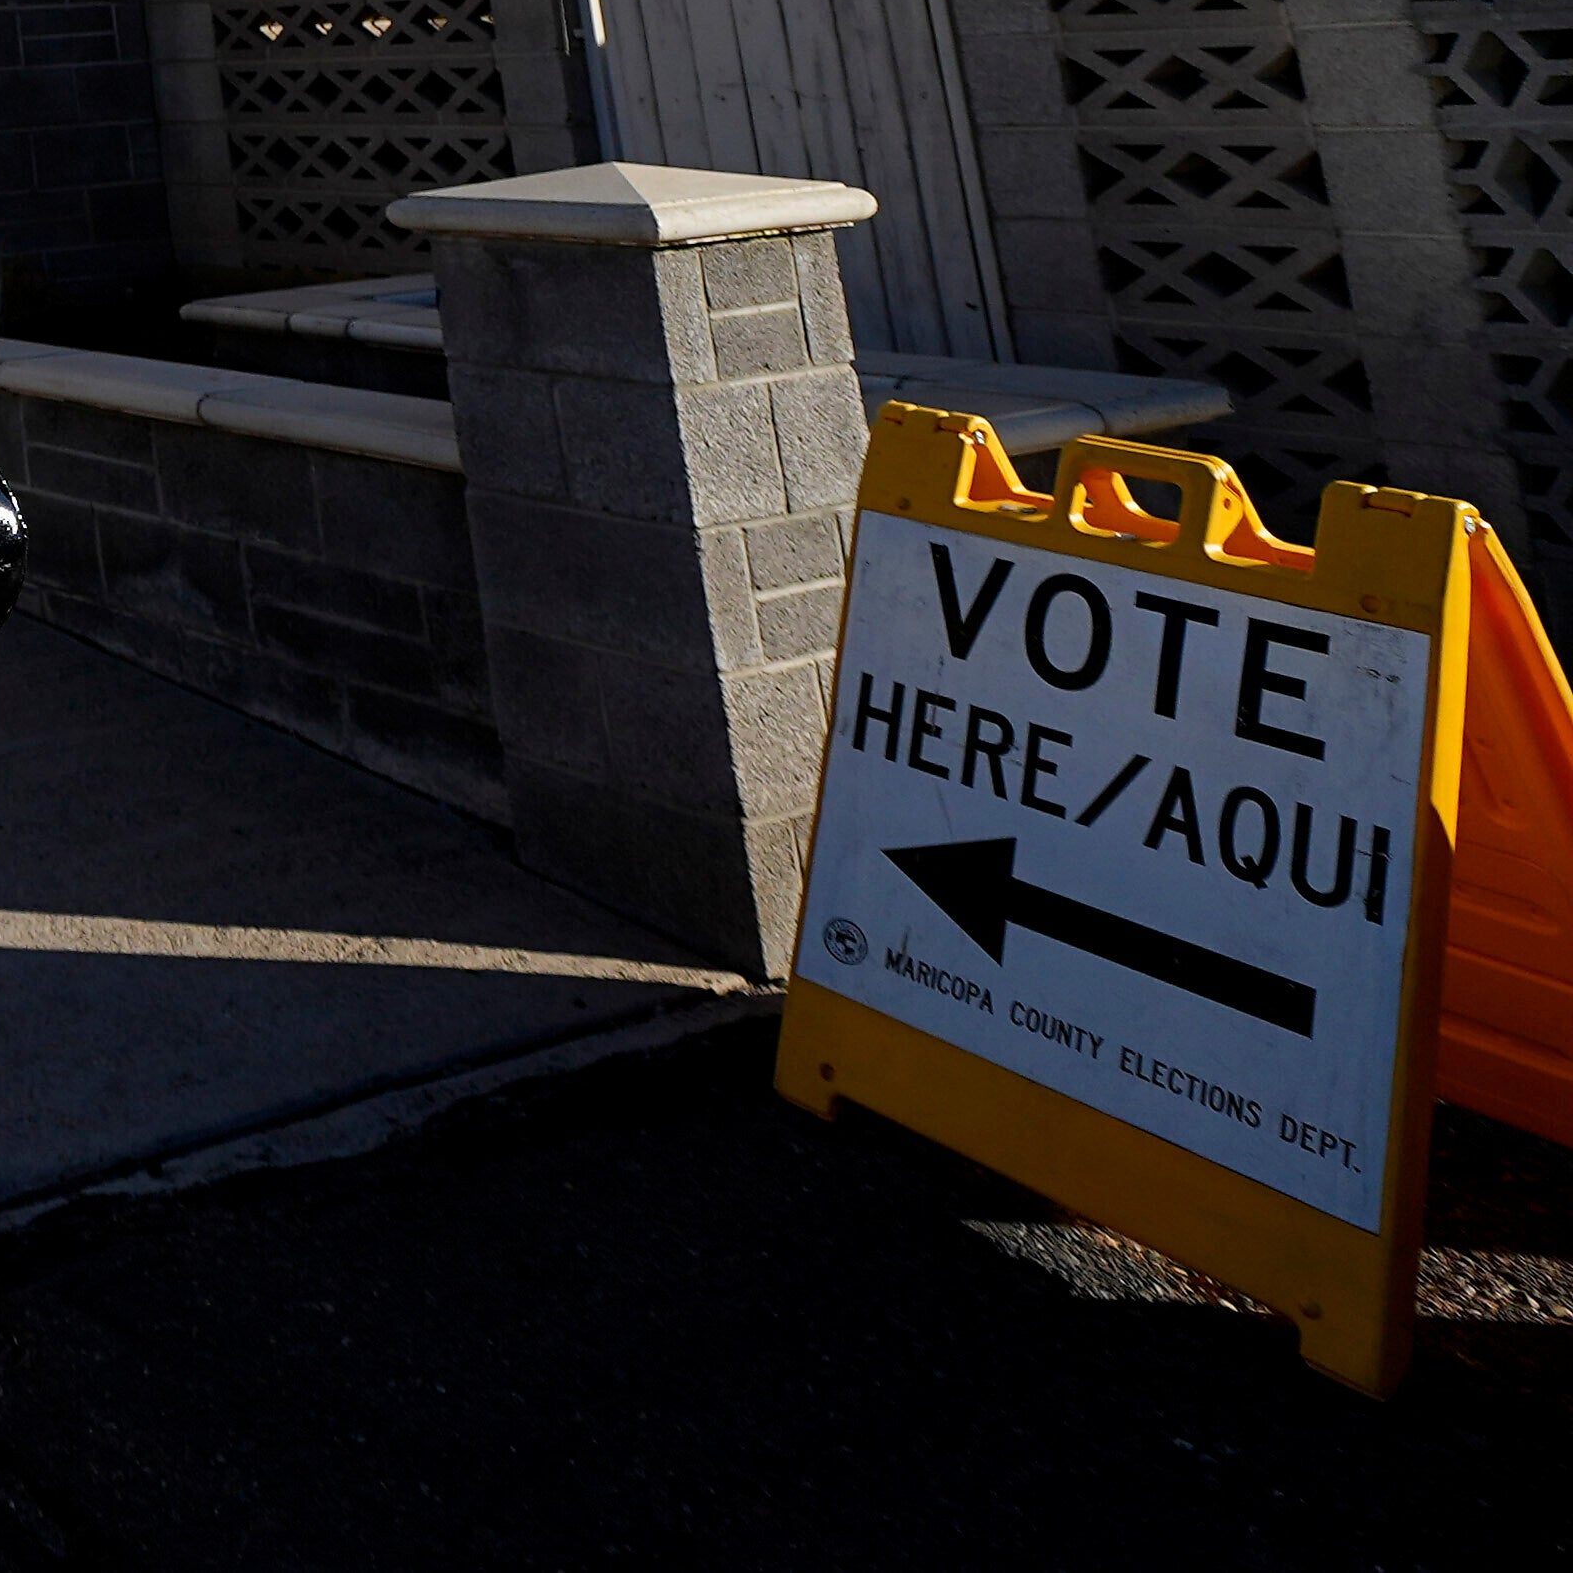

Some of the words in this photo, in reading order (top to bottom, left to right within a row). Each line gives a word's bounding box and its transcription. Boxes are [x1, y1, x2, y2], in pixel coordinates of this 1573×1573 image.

[930, 542, 1331, 762] VOTE
[852, 672, 1391, 926] HERE/AQUI
[884, 946, 994, 1015] MARICOPA
[1008, 999, 1104, 1060] COUNTY
[1120, 1045, 1263, 1128] ELECTIONS
[1279, 1113, 1362, 1174] DEPT.
